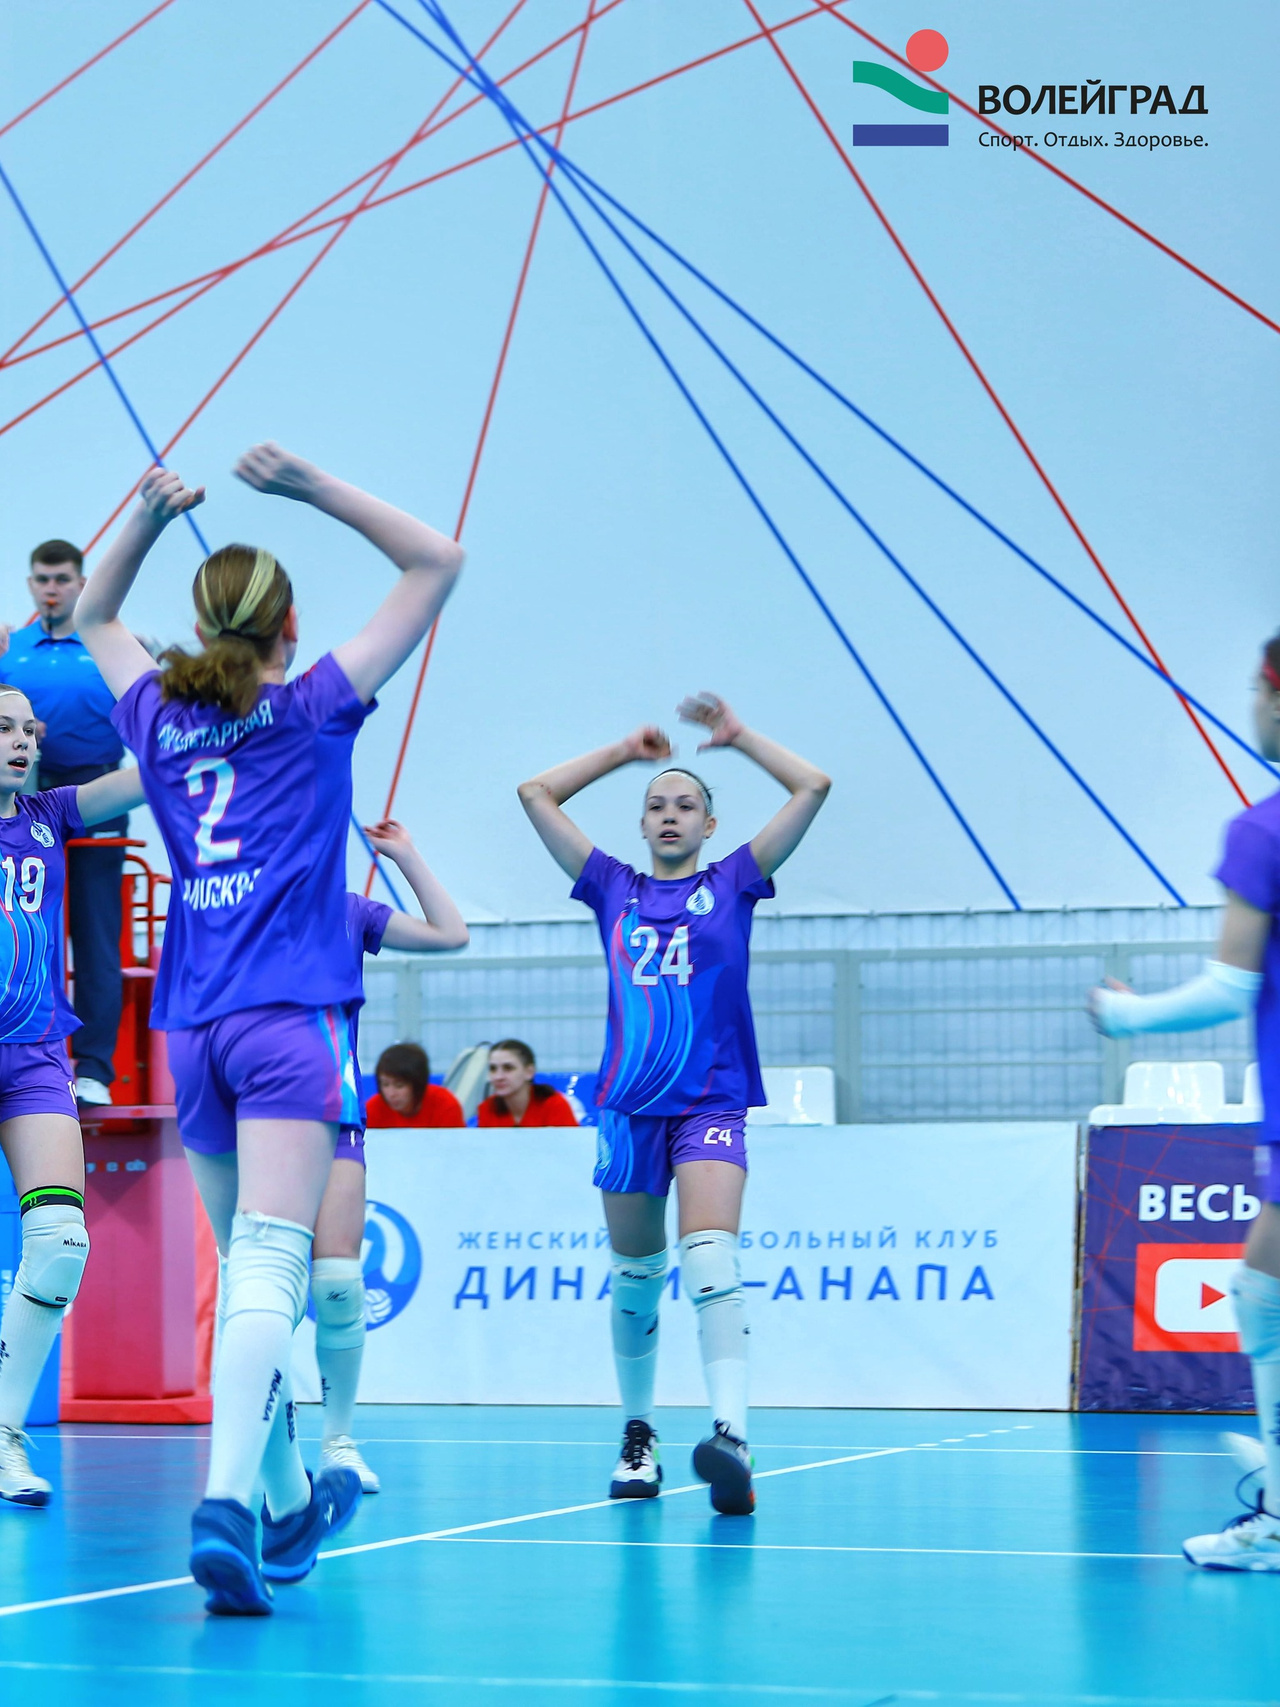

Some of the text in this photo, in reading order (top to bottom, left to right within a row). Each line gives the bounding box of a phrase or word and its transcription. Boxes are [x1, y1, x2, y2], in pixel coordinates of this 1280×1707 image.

[184, 757, 241, 865] 2
[1, 856, 46, 913] 19
[629, 924, 694, 987] 24
[1138, 1184, 1262, 1222] ВЕСЬ
[457, 1227, 612, 1249] ЖЕНСКИЙ
[915, 1229, 999, 1249] КЛУБ
[454, 1264, 995, 1309] ДИН—АНАПА
